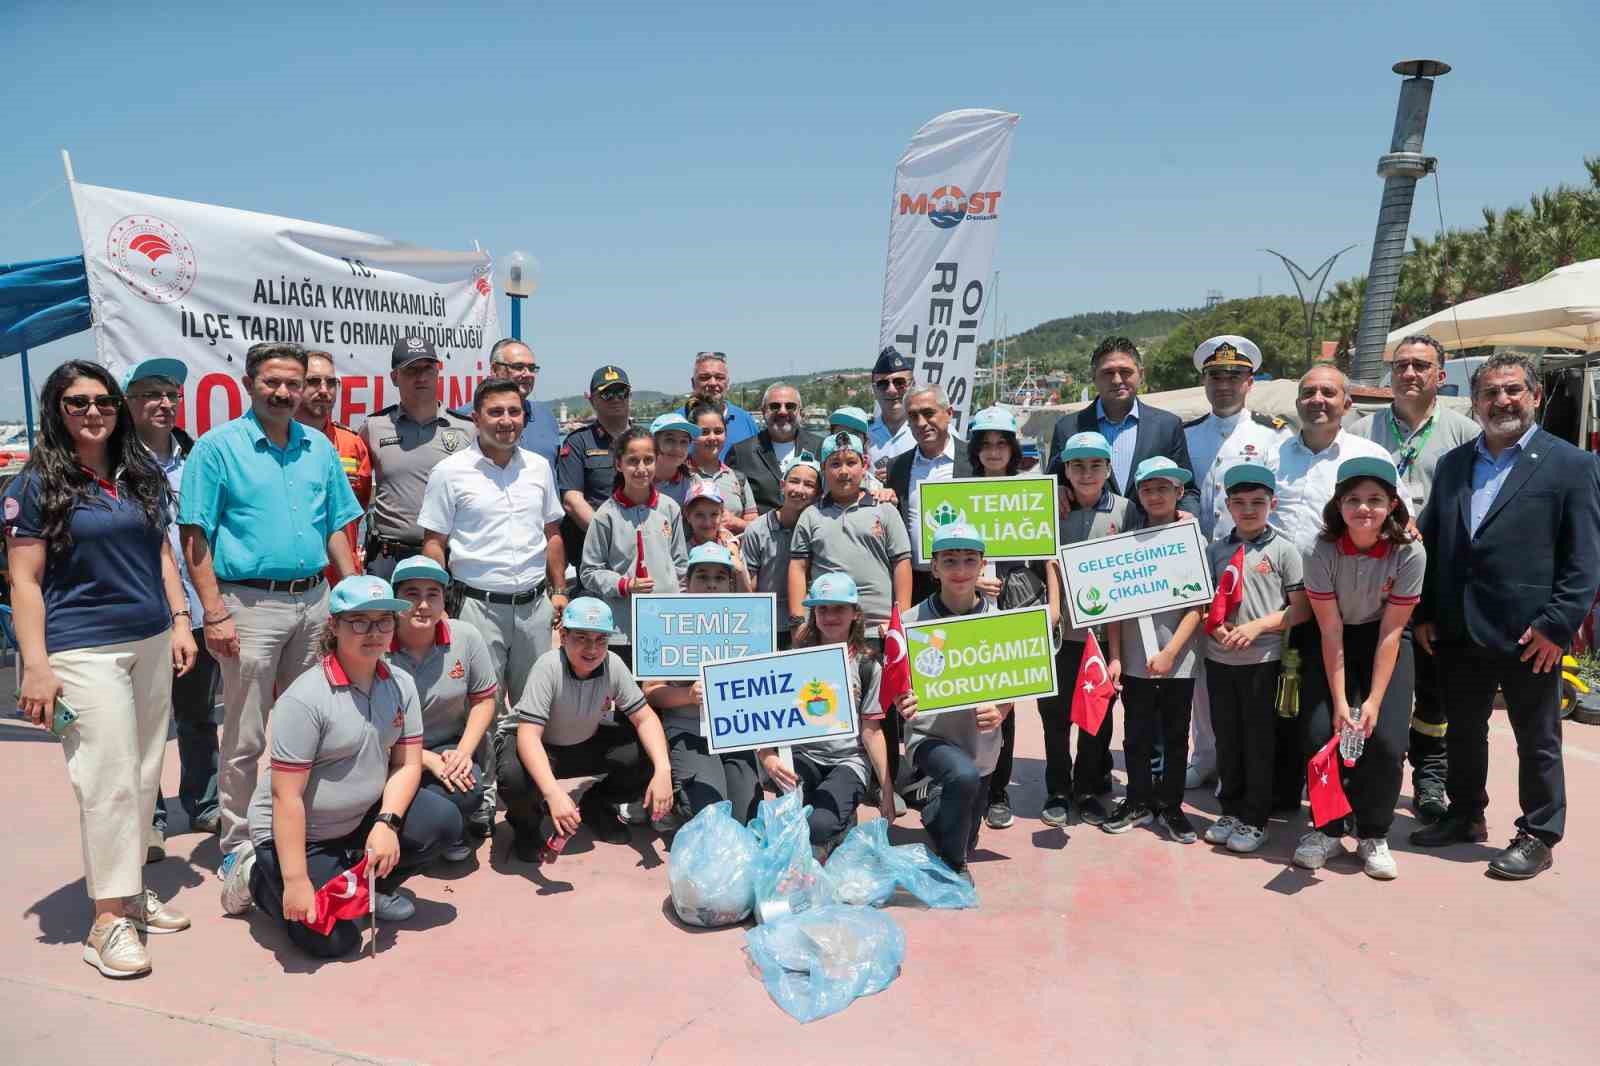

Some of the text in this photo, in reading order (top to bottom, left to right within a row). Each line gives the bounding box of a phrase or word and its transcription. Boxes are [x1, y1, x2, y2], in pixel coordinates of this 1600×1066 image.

[341, 257, 376, 278] T.C.
[253, 275, 446, 317] ALİAĞA KAYMAKAMLIĞI
[181, 305, 233, 346] İLÇE
[237, 315, 304, 343] TARIM
[310, 319, 335, 344] VE
[340, 321, 400, 346] ORMAN
[953, 280, 983, 361] OIL
[969, 489, 1045, 513] TEMİZ
[971, 517, 1053, 541] LİAĞA
[659, 607, 750, 635] TEMİZ
[948, 637, 1047, 668] DOĞAMIZI
[714, 669, 795, 701] TEMİZ
[925, 666, 1048, 698] KORUYALIM
[714, 708, 806, 736] DÜNYA
